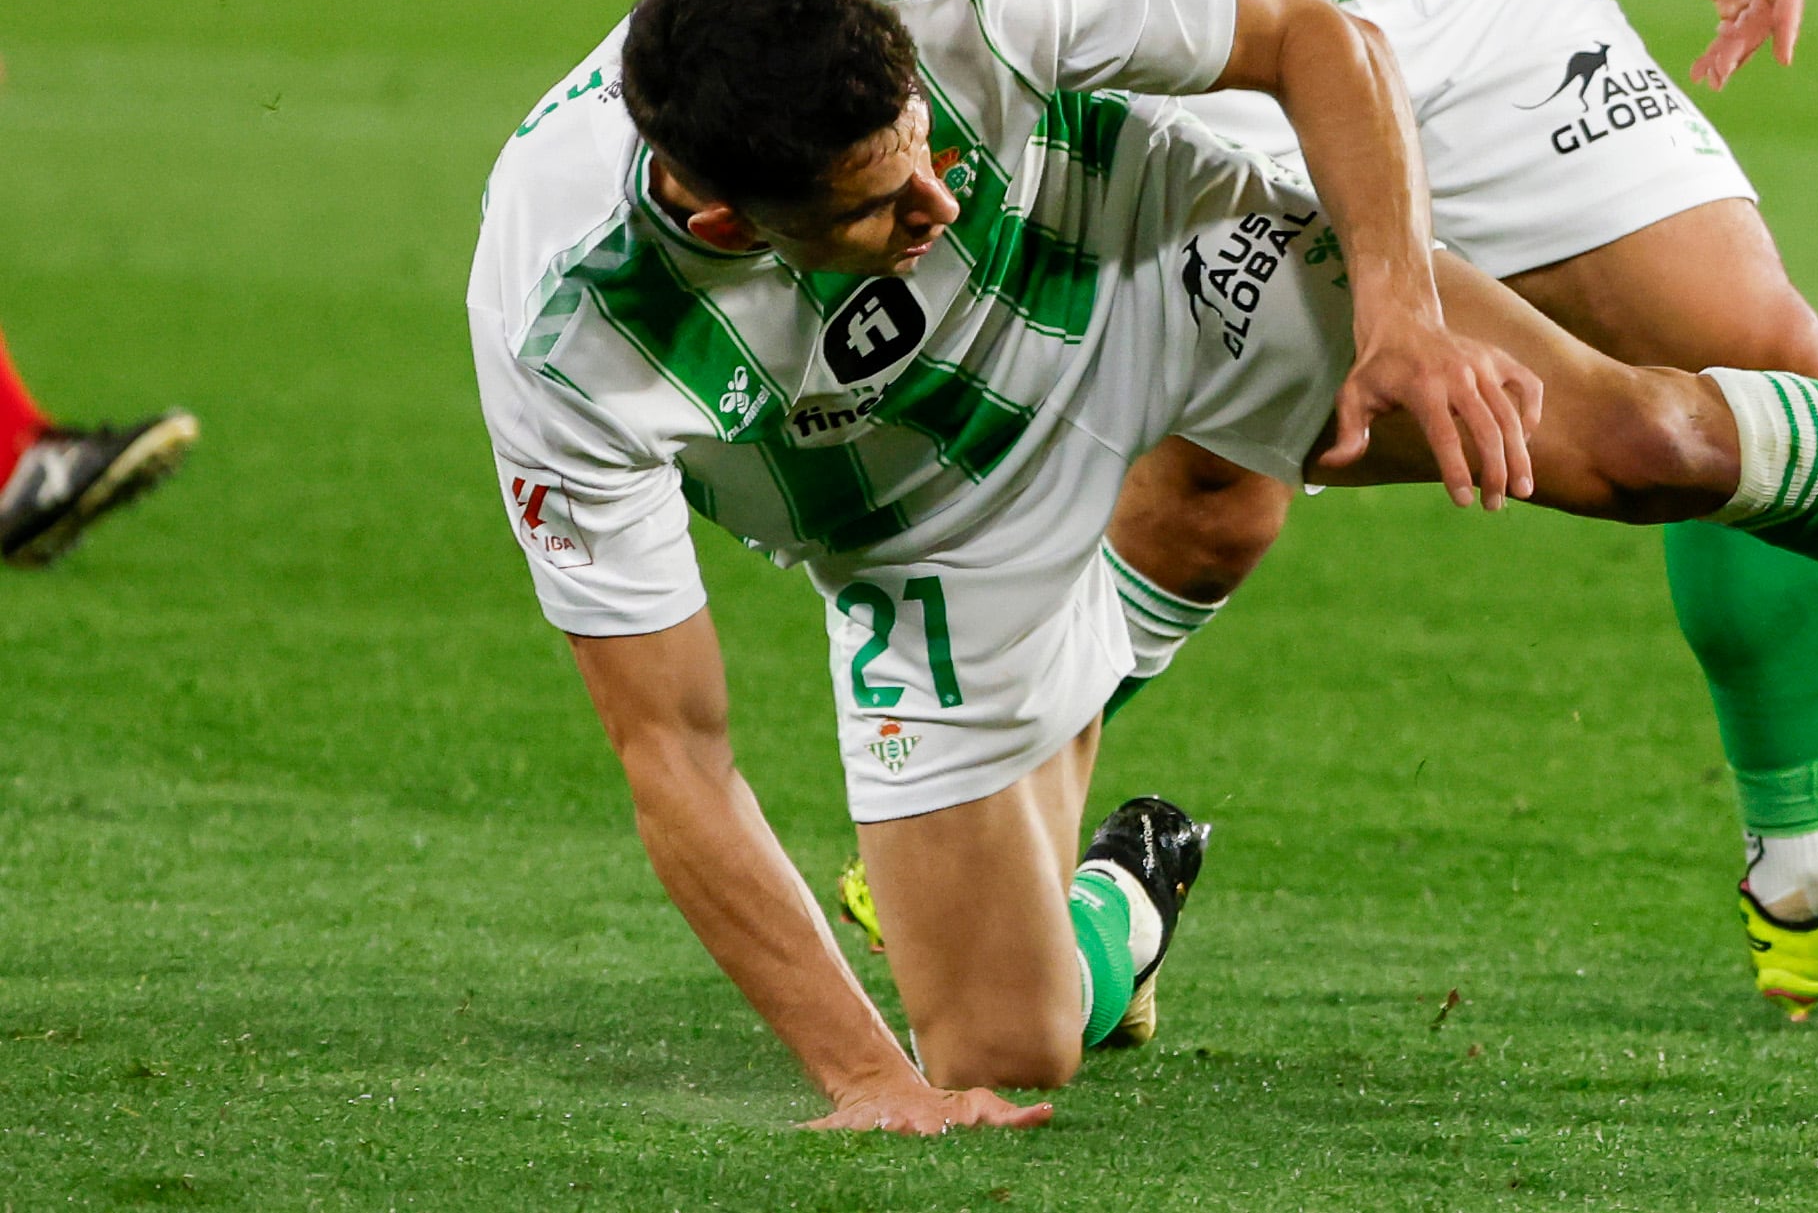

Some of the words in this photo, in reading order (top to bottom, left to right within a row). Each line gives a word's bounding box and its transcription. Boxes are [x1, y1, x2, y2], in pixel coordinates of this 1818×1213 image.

[1603, 69, 1668, 105] AUS
[1208, 212, 1272, 299] AUS
[1222, 210, 1318, 361] GLOBAL
[792, 390, 885, 438] fine
[836, 575, 963, 709] 21
